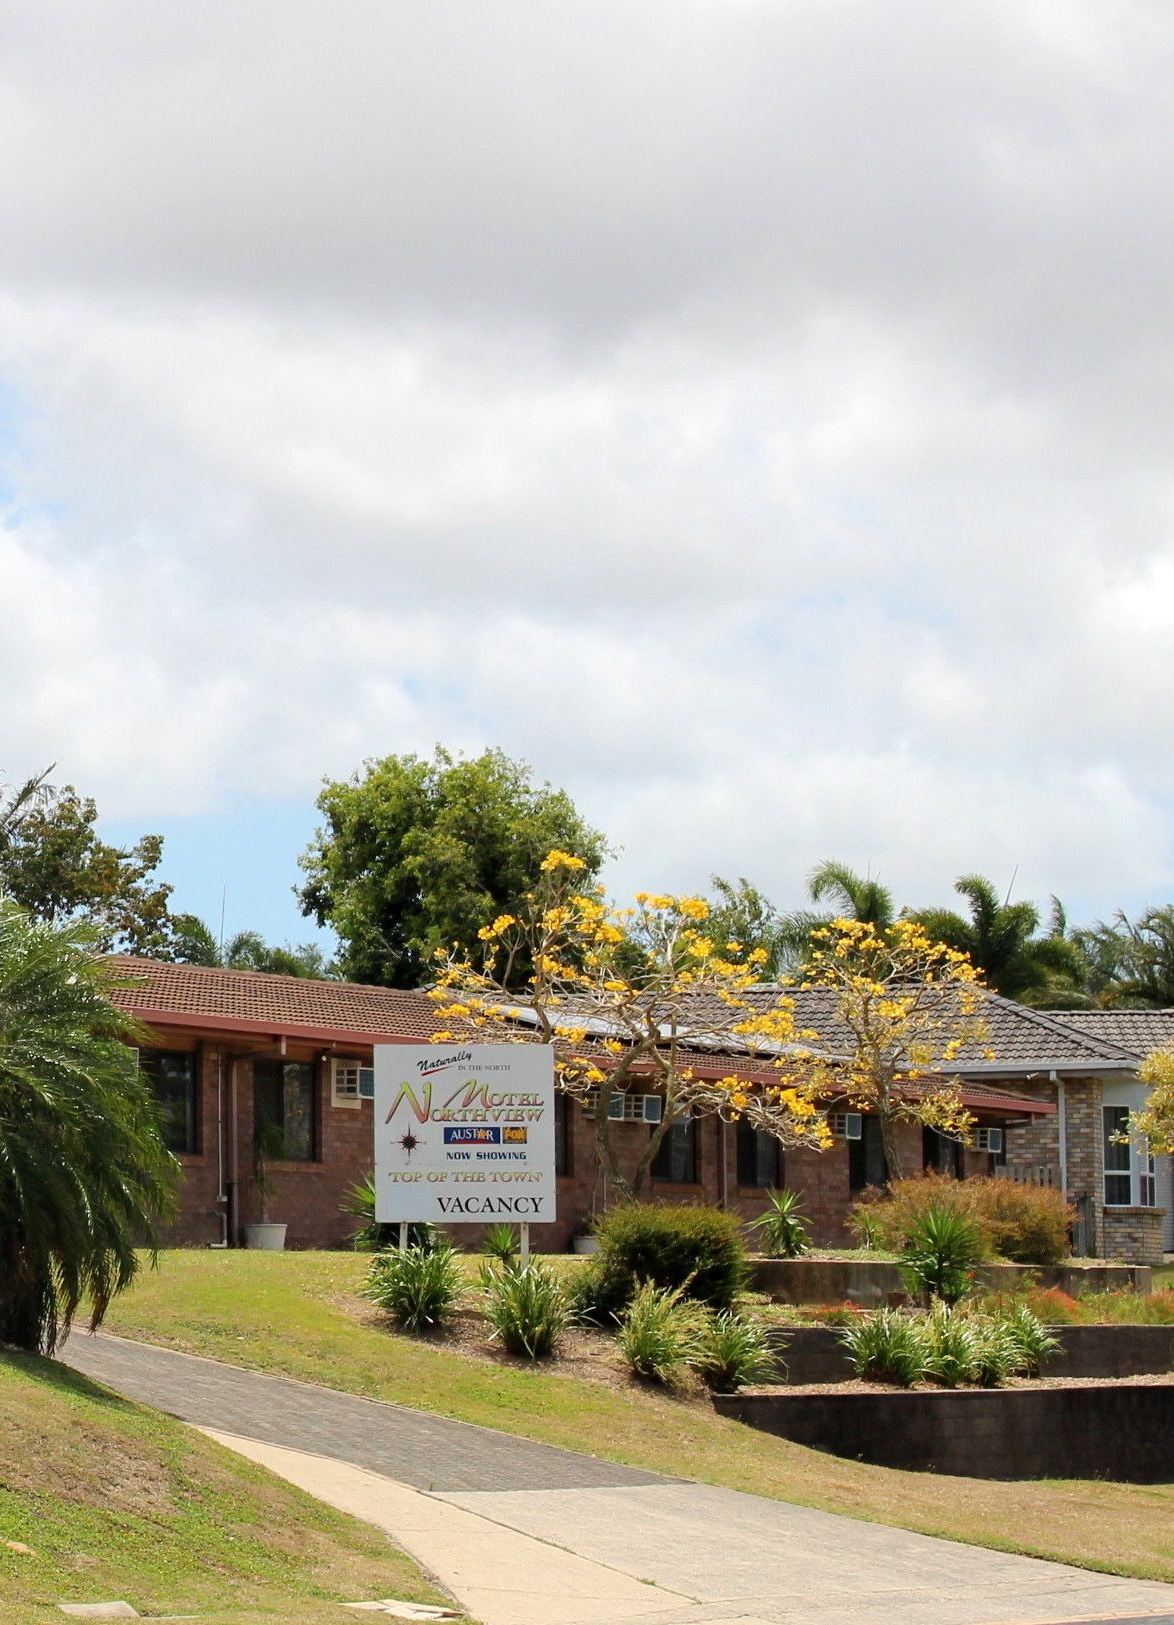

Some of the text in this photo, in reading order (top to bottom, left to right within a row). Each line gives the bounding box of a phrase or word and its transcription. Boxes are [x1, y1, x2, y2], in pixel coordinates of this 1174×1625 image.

[416, 1050, 473, 1072] Naturally
[385, 1080, 545, 1124] NORTHVIEW
[443, 1078, 545, 1108] MOTEL
[446, 1151, 526, 1160] NOW SHOWING
[426, 1171, 448, 1183] OF
[451, 1171, 486, 1183] THE
[437, 1197, 544, 1214] VACANCY
